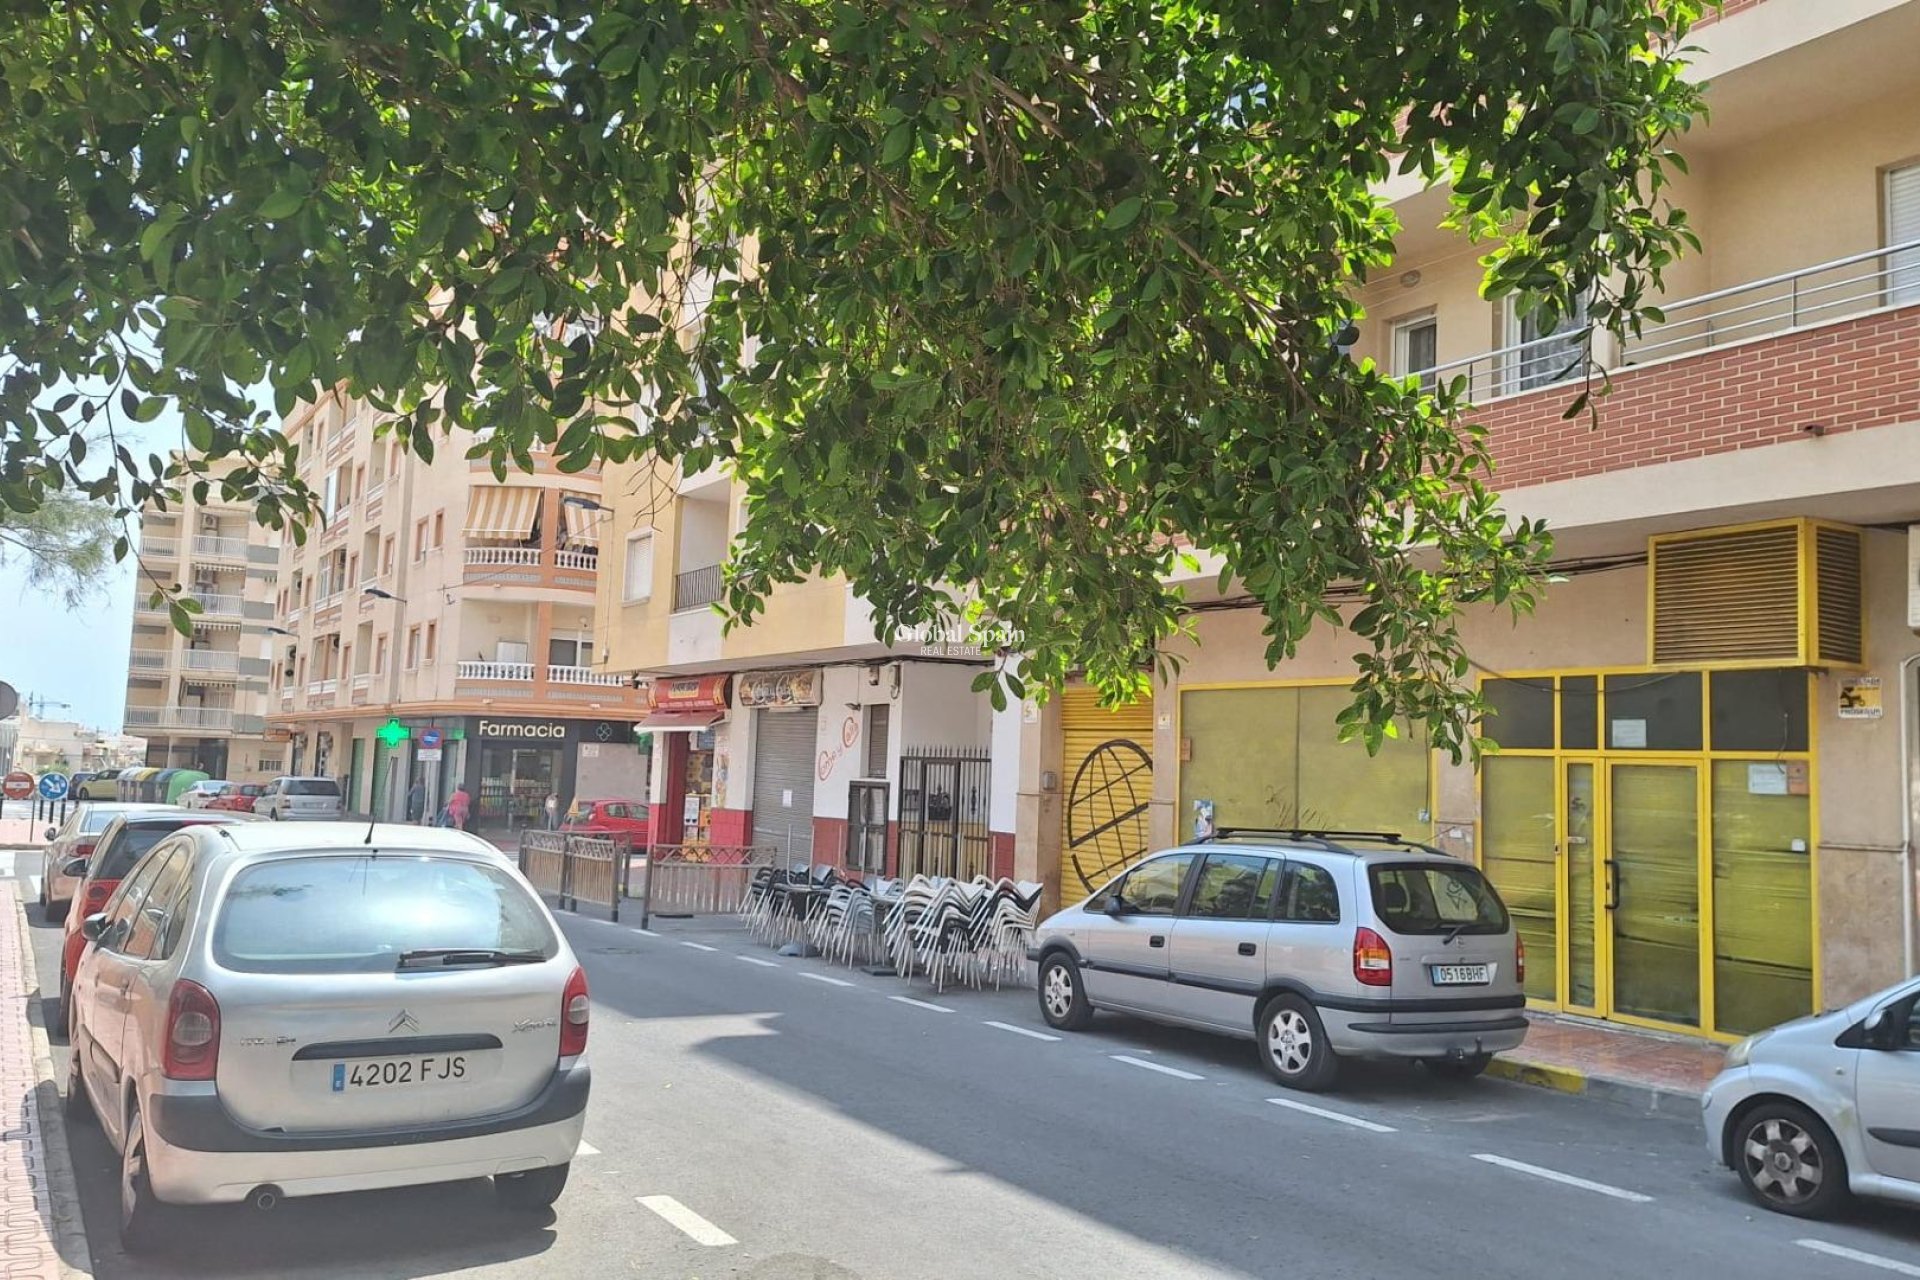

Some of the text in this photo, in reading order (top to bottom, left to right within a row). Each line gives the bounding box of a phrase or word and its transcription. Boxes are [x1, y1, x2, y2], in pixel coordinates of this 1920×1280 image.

[478, 720, 566, 738] Farmacia
[349, 1056, 467, 1087] 4202 FJS
